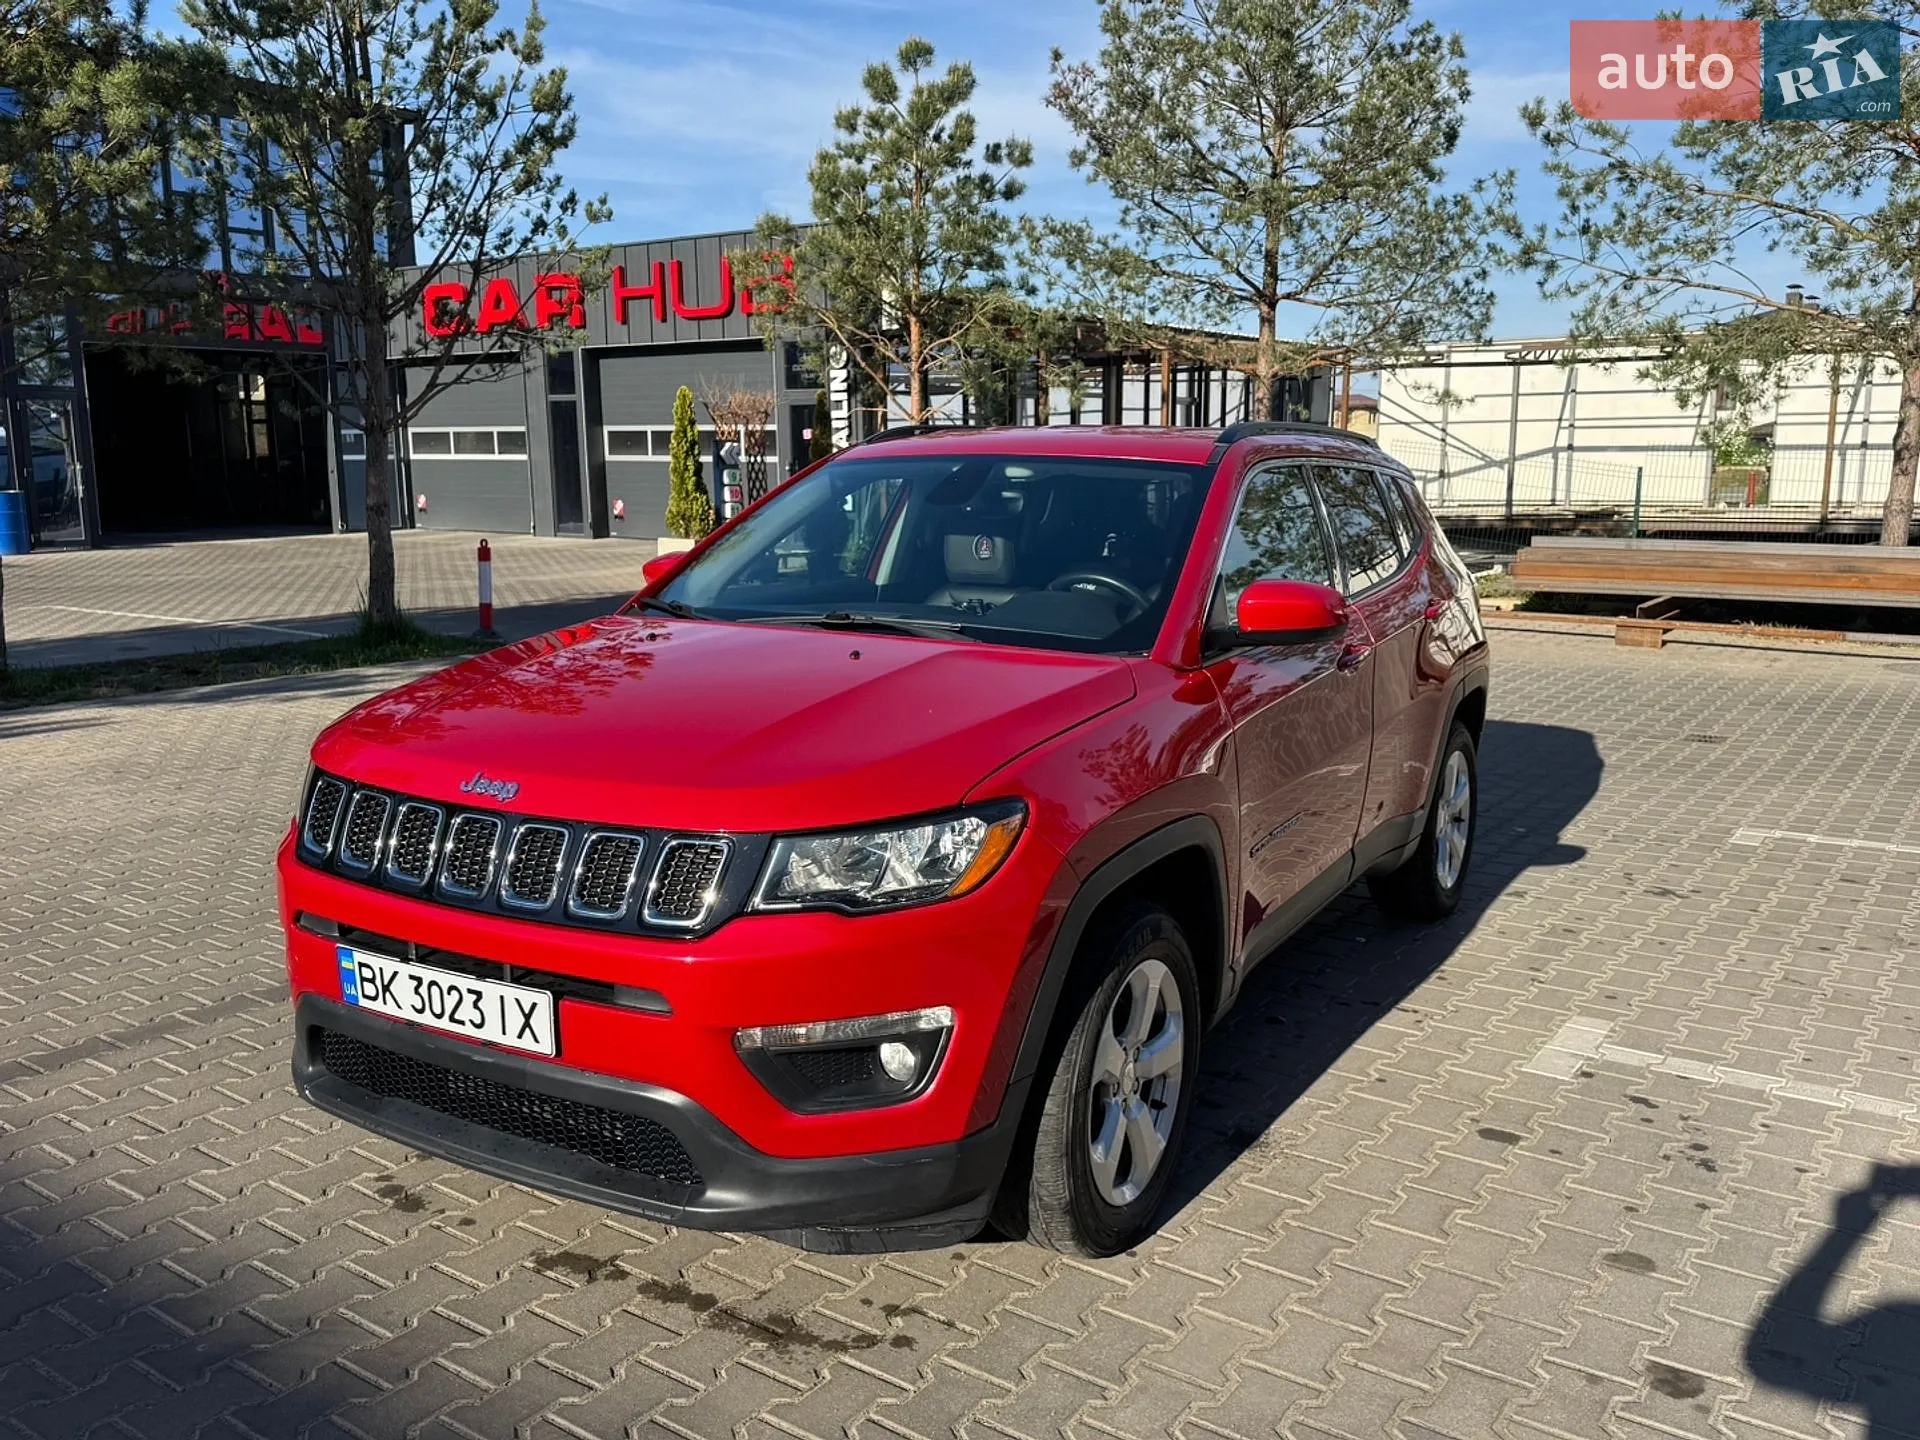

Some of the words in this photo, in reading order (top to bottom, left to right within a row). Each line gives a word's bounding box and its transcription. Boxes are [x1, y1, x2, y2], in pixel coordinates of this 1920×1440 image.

[424, 272, 587, 338] CAR
[829, 344, 850, 454] AILING
[460, 772, 519, 803] Jeep
[344, 981, 358, 996] UA
[358, 961, 403, 1010] BK
[408, 974, 486, 1030] 3023
[500, 994, 541, 1044] IX
